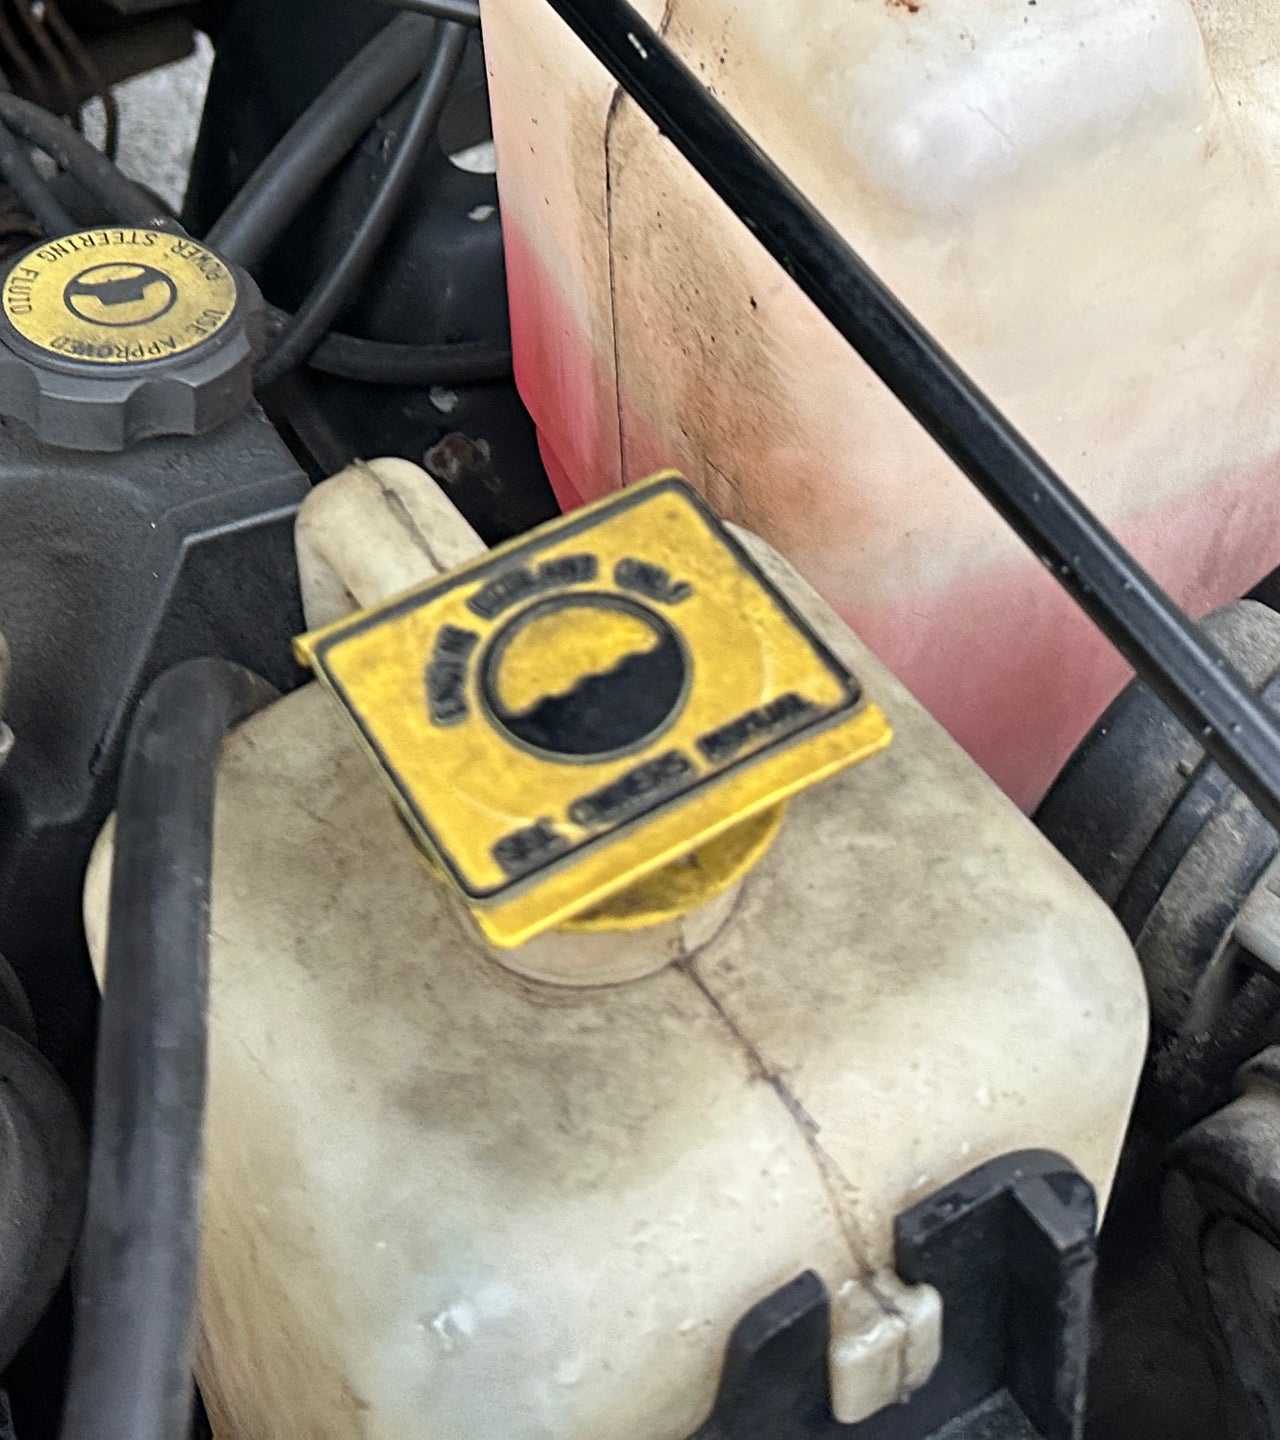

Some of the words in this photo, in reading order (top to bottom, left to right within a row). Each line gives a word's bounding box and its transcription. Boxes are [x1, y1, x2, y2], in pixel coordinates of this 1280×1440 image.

[35, 231, 159, 264] STEERING
[170, 238, 222, 282] POWER
[8, 266, 40, 315] FLUID
[187, 309, 226, 338] USE
